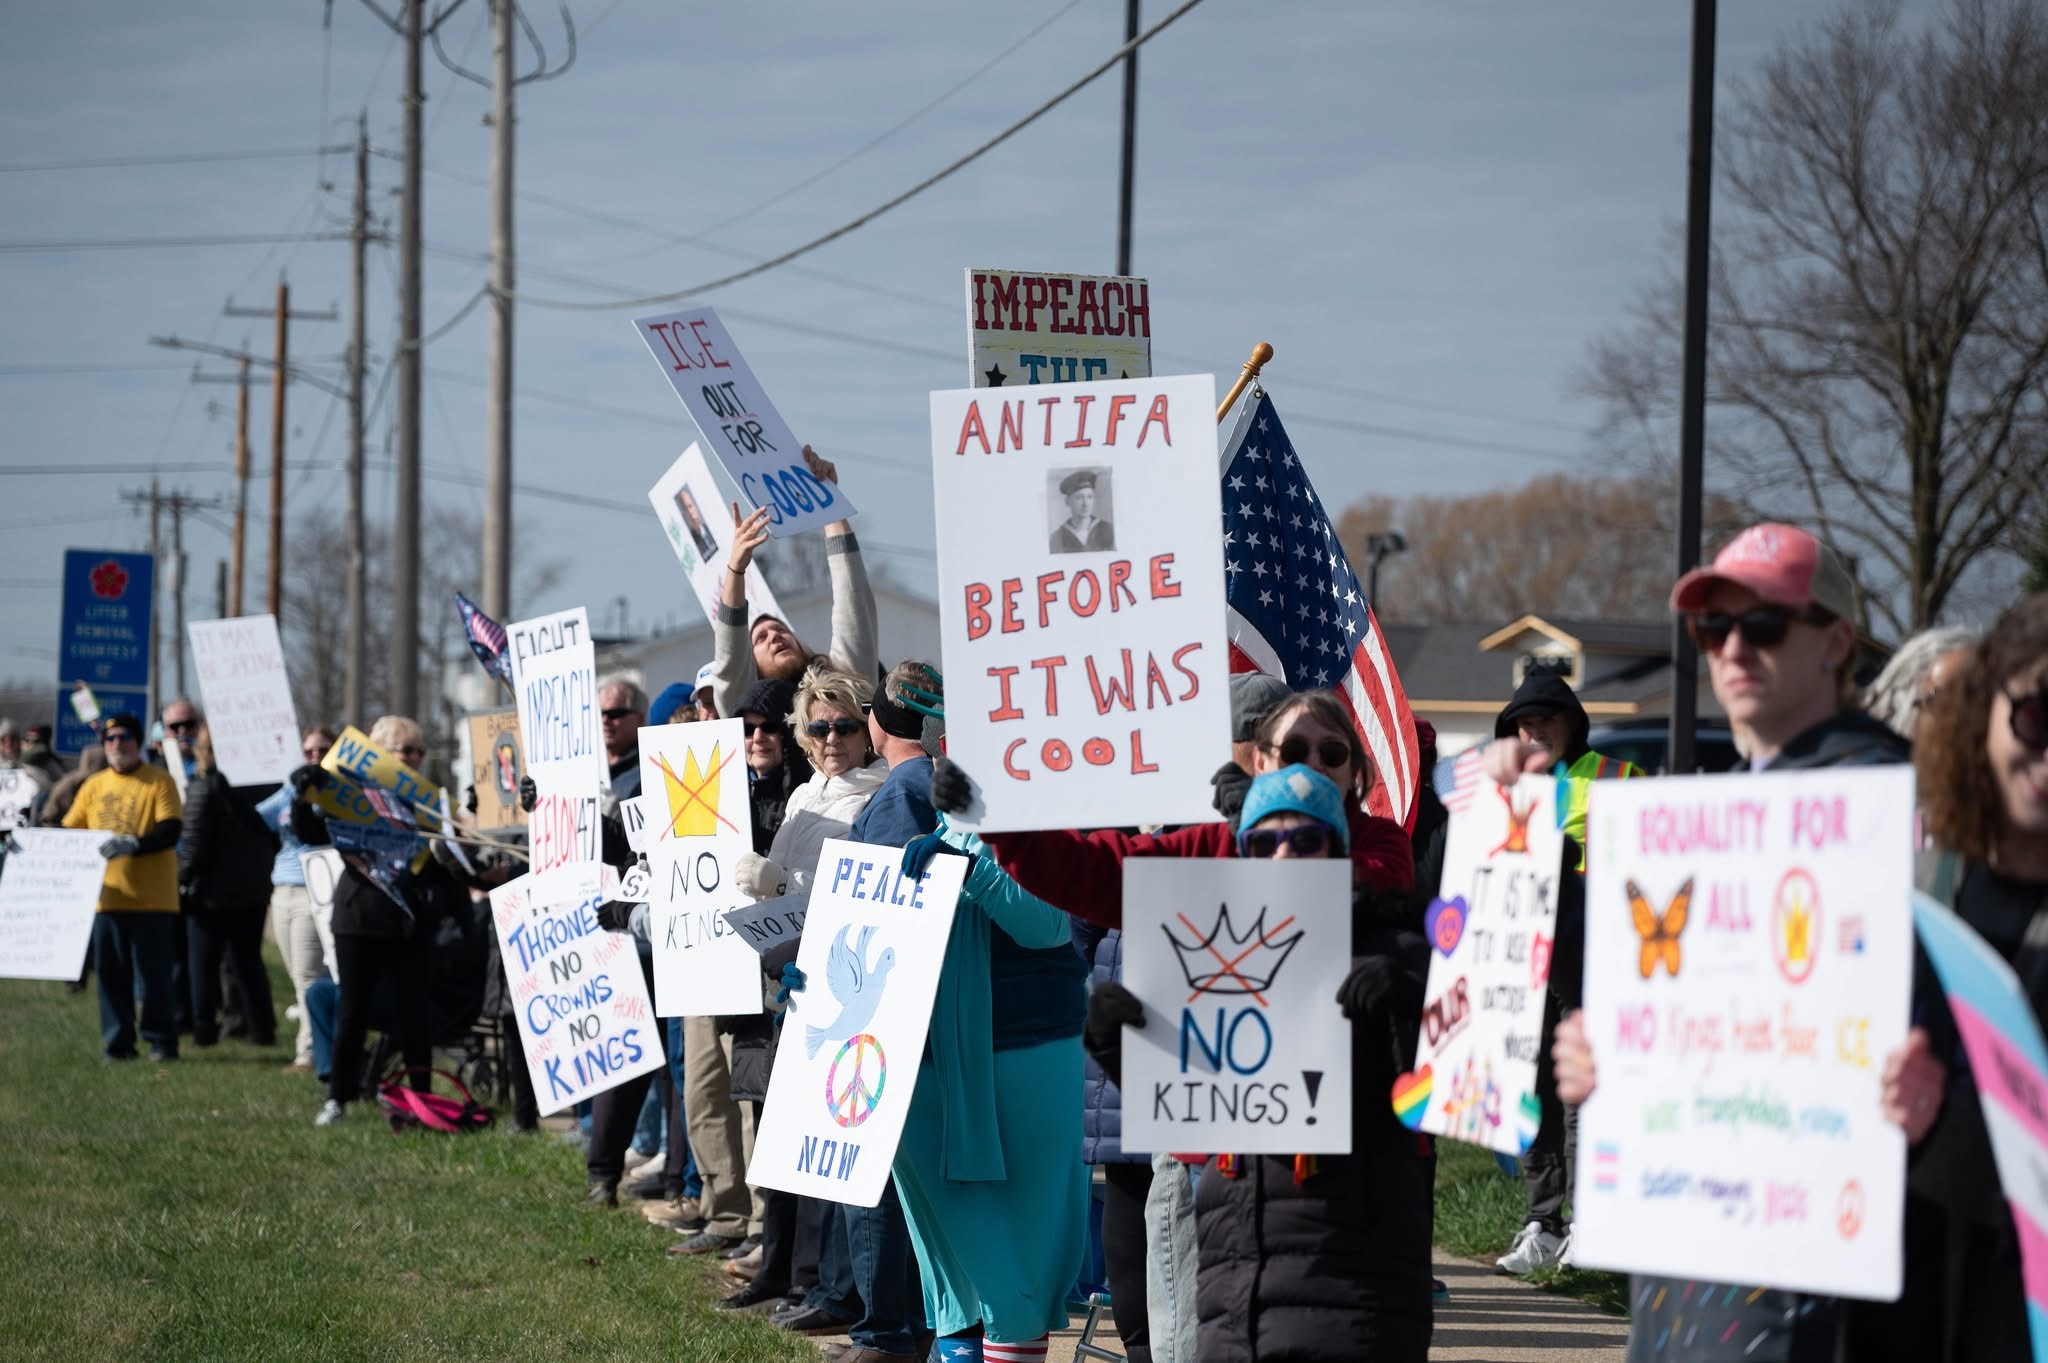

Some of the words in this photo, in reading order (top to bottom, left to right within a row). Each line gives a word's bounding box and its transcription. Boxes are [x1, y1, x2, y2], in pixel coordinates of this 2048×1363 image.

[973, 274, 1150, 338] IMPEACH
[648, 320, 732, 373] ICE
[702, 381, 747, 418] OUT
[956, 394, 1172, 455] ANTIFA
[722, 420, 777, 456] FOR
[741, 465, 834, 525] GOOD
[965, 553, 1181, 641] BEFORE
[70, 643, 138, 661] COURTESY
[987, 655, 1067, 723] IT
[1085, 642, 1202, 716] WAS
[527, 668, 592, 764] IMPEACH
[337, 737, 378, 778] WE
[1003, 729, 1160, 781] COOL
[1639, 800, 1766, 854] EQUALITY
[1791, 795, 1848, 850] FOR
[670, 851, 720, 902] NO
[832, 858, 931, 909] PEACE
[666, 906, 737, 950] KINGS
[743, 917, 783, 941] NO
[1707, 881, 1753, 932] ALL
[508, 896, 603, 973] THRONES
[550, 951, 582, 985] NO
[527, 975, 613, 1036] CROWNS
[569, 1014, 600, 1047] NO
[1616, 1004, 1657, 1053] NO
[544, 1029, 643, 1101] KINGS
[1180, 1006, 1272, 1076] NO
[1154, 1070, 1324, 1126] KINGS!
[797, 1134, 861, 1182] NOW
